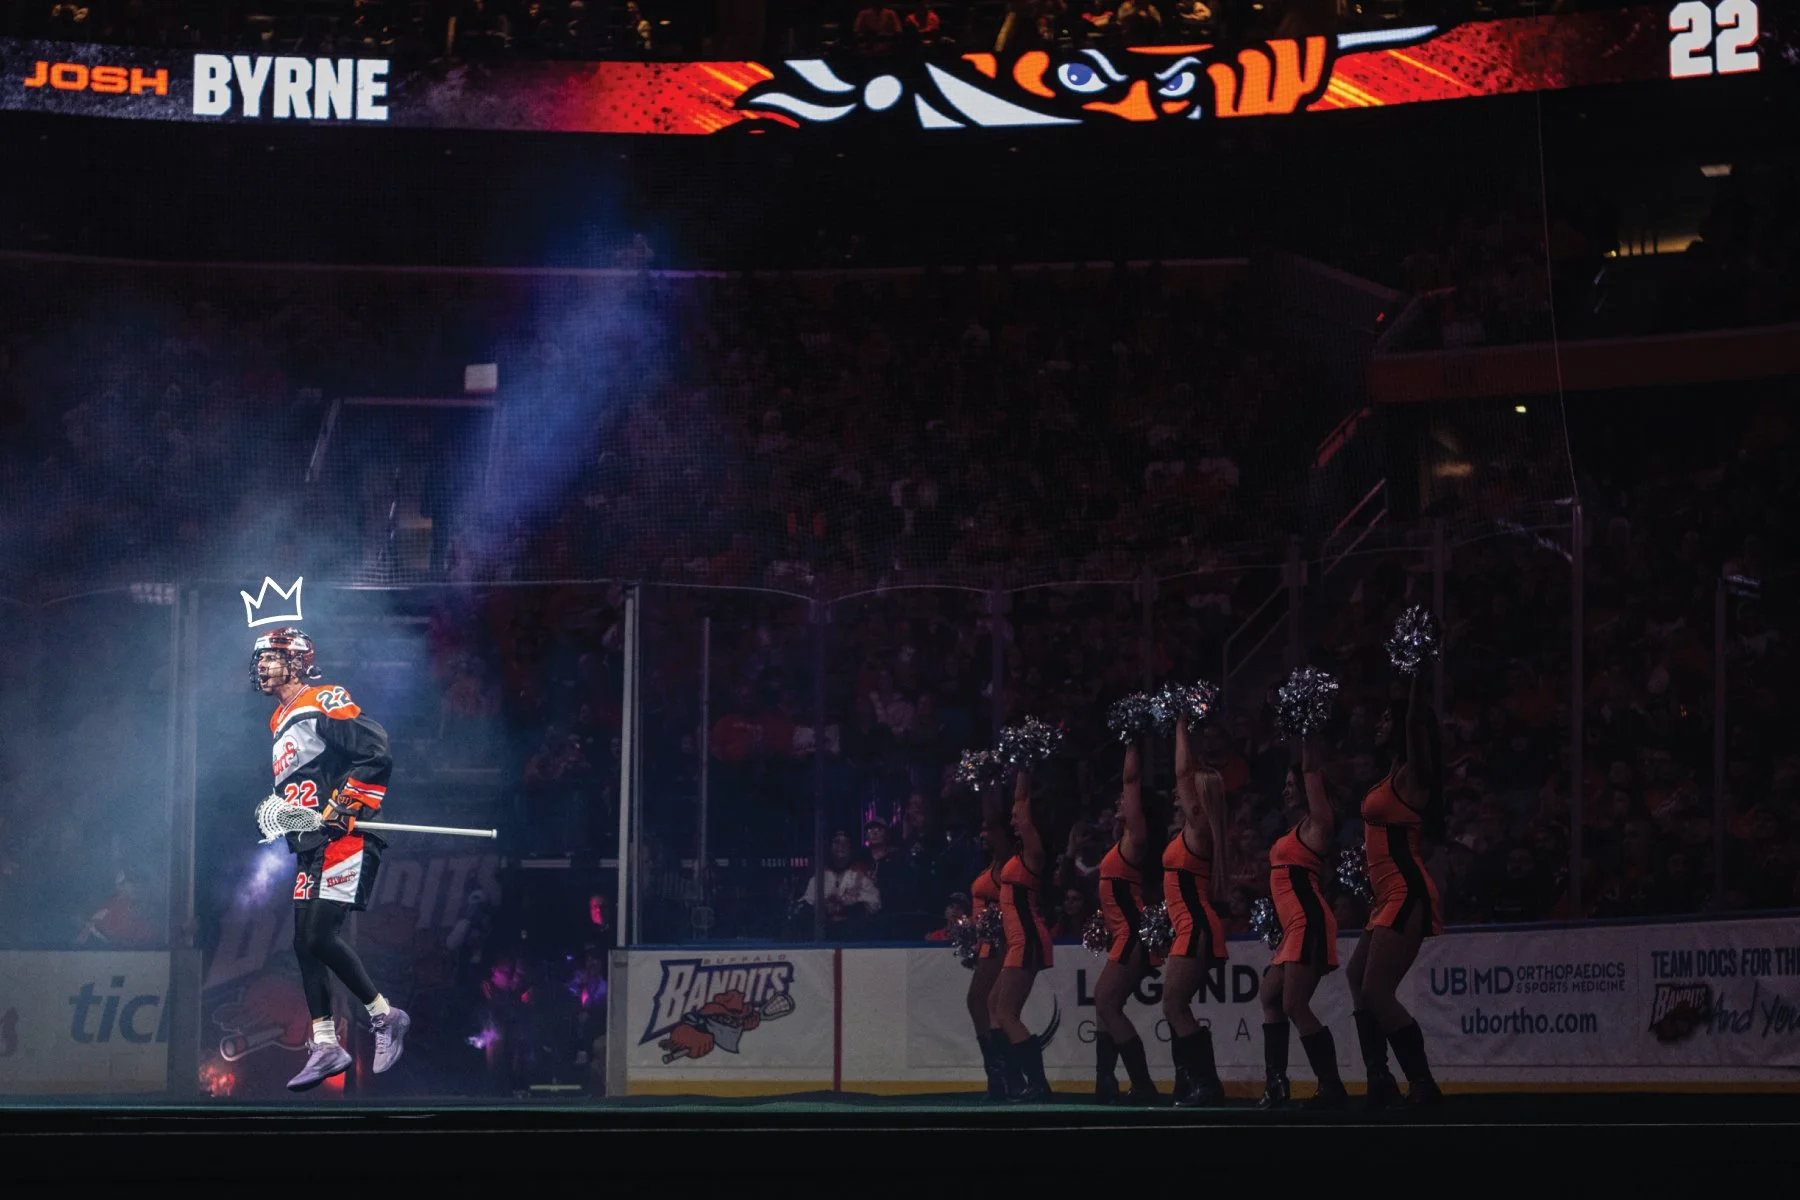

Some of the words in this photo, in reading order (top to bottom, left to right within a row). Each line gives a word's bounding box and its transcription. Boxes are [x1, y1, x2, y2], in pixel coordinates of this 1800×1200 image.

[1668, 0, 1760, 79] 22
[24, 61, 168, 95] JOSH
[193, 53, 390, 120] BYRNE
[316, 686, 355, 713] 22
[284, 780, 319, 807] 22
[1516, 962, 1626, 981] ORTHOPAEDICS
[1651, 950, 1693, 978] TEAM
[1697, 949, 1737, 977] DOCS
[1741, 948, 1771, 976] FOR
[645, 961, 792, 1036] BANDITS
[1077, 964, 1272, 1006] LGND
[1525, 981, 1568, 994] SPORTS
[1572, 980, 1625, 992] MEDICINE
[1461, 1007, 1598, 1034] ubortho.com
[1706, 980, 1758, 1036] And
